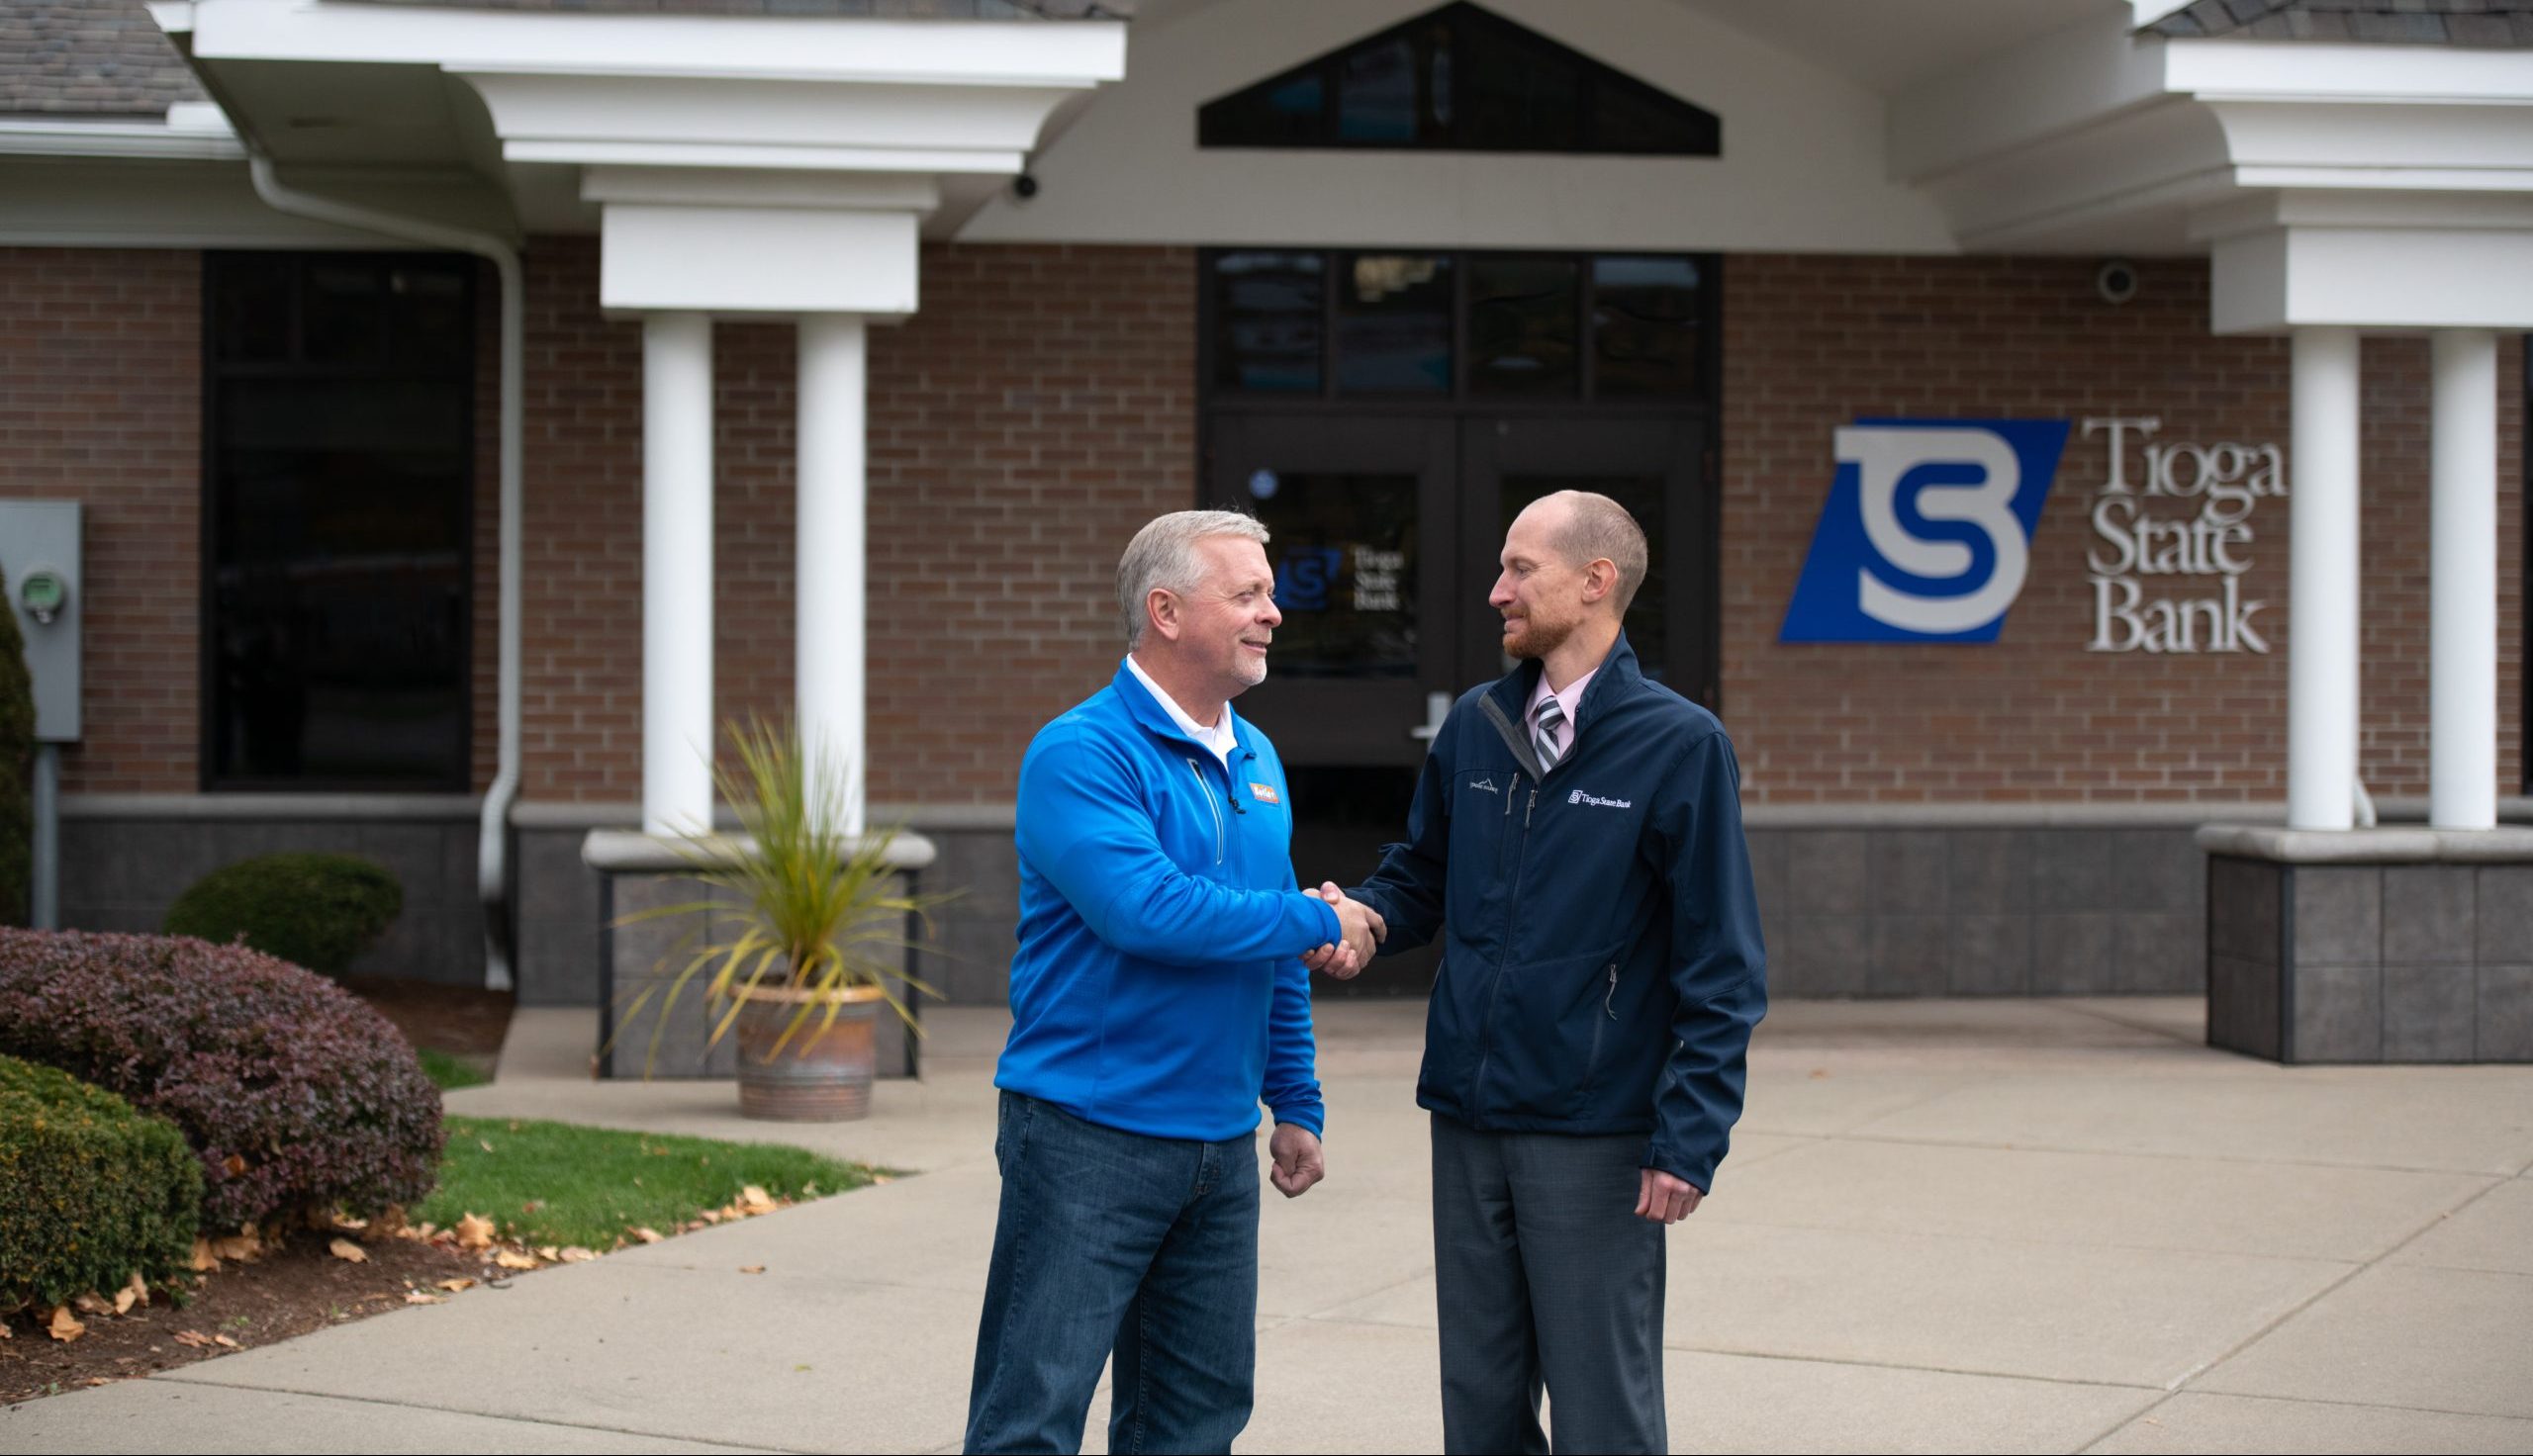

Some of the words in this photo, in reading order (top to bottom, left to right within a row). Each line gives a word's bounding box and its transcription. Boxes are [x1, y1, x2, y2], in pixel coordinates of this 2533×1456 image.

[2081, 415, 2288, 526] Tioga
[2086, 497, 2256, 576] State
[2086, 575, 2271, 654] Bank
[1582, 793, 1600, 805] Tioga
[1600, 796, 1616, 806] State
